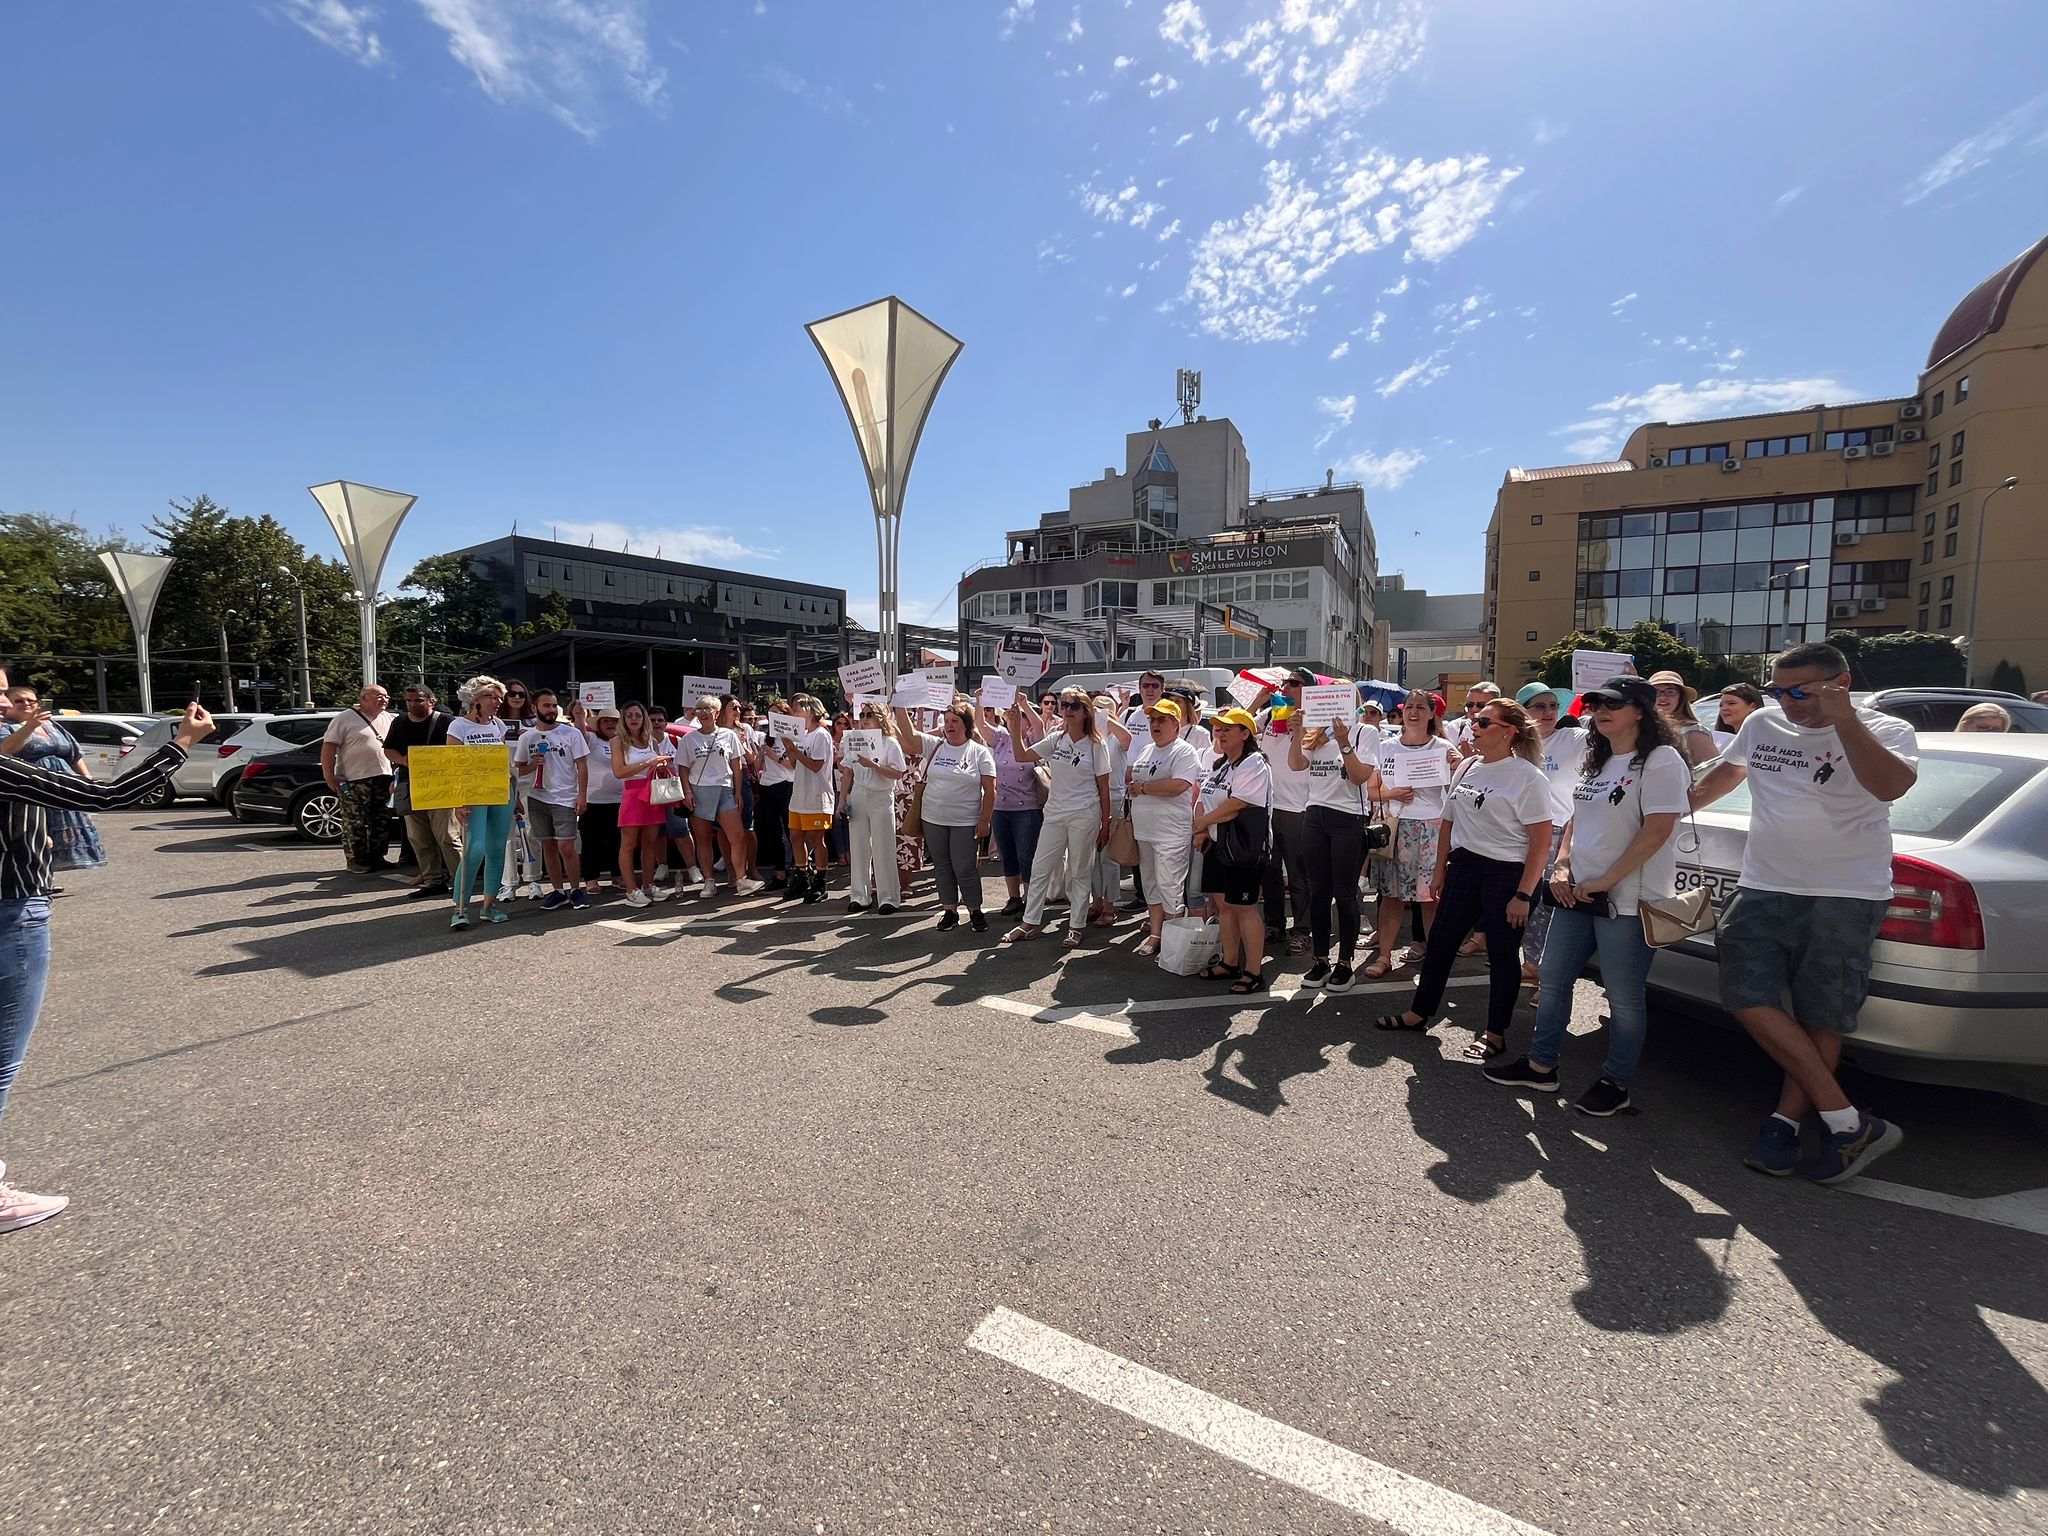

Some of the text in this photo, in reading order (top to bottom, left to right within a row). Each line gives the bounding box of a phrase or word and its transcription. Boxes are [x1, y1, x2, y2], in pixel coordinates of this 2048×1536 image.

[1191, 544, 1288, 563] SMILEVISION
[1191, 559, 1273, 571] clică stomatologică
[1755, 744, 1803, 758] FĂRĂ HAOS
[1751, 751, 1809, 770] ÎN LEGISLAȚIA
